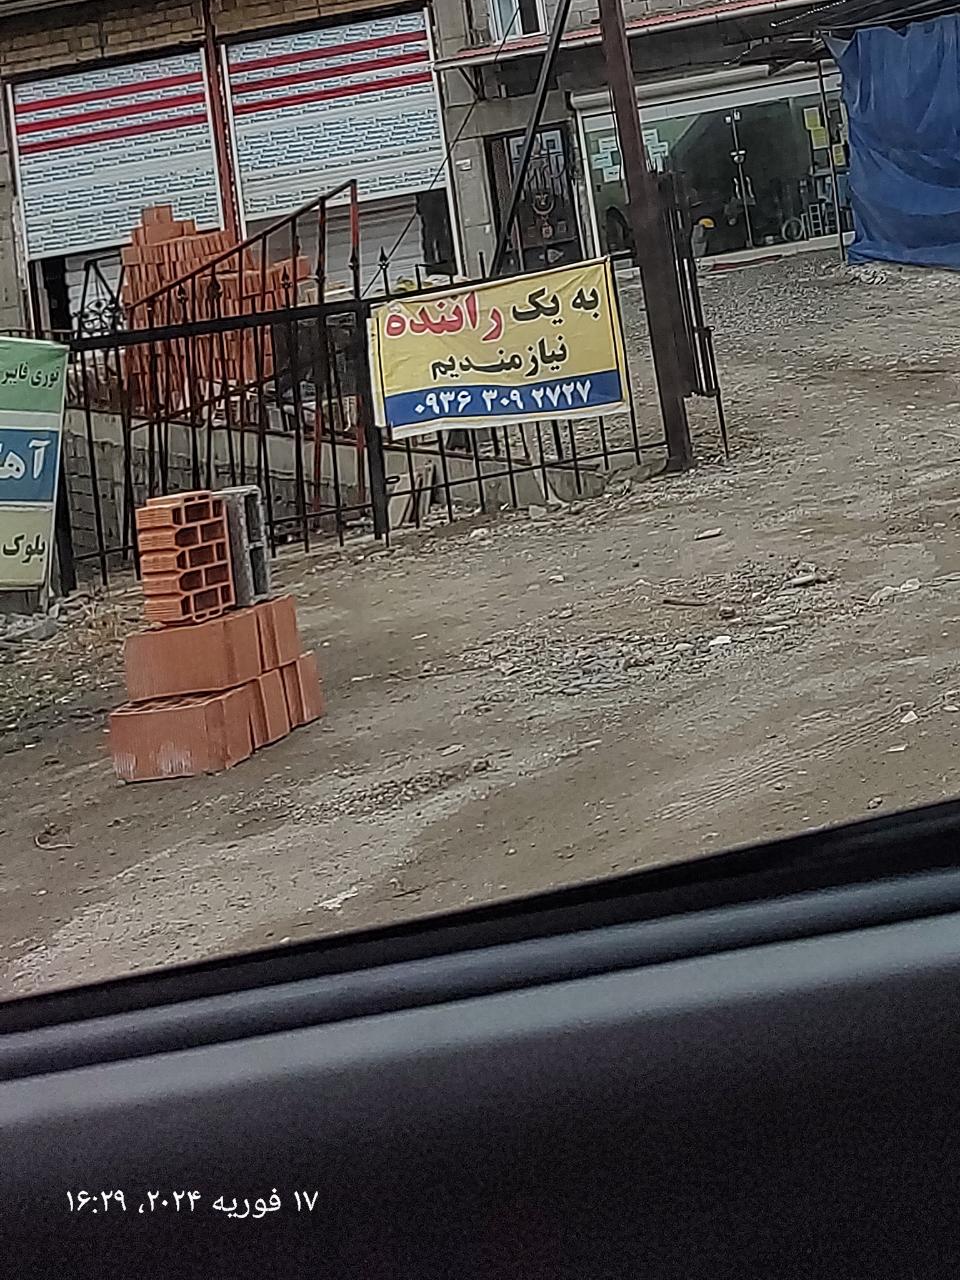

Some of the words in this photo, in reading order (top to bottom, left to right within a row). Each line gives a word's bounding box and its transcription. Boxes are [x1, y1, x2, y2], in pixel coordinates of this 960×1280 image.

[385, 291, 504, 341] راننده
[511, 287, 561, 324] یک
[571, 286, 600, 319] به
[431, 335, 568, 381] نیازمندیم
[414, 390, 472, 415] ۰۹۳۶
[481, 388, 525, 412] ۳۰۹
[531, 379, 592, 409] ۲۷۲۷
[0, 439, 51, 479] آه
[2, 534, 46, 563] بلوک
